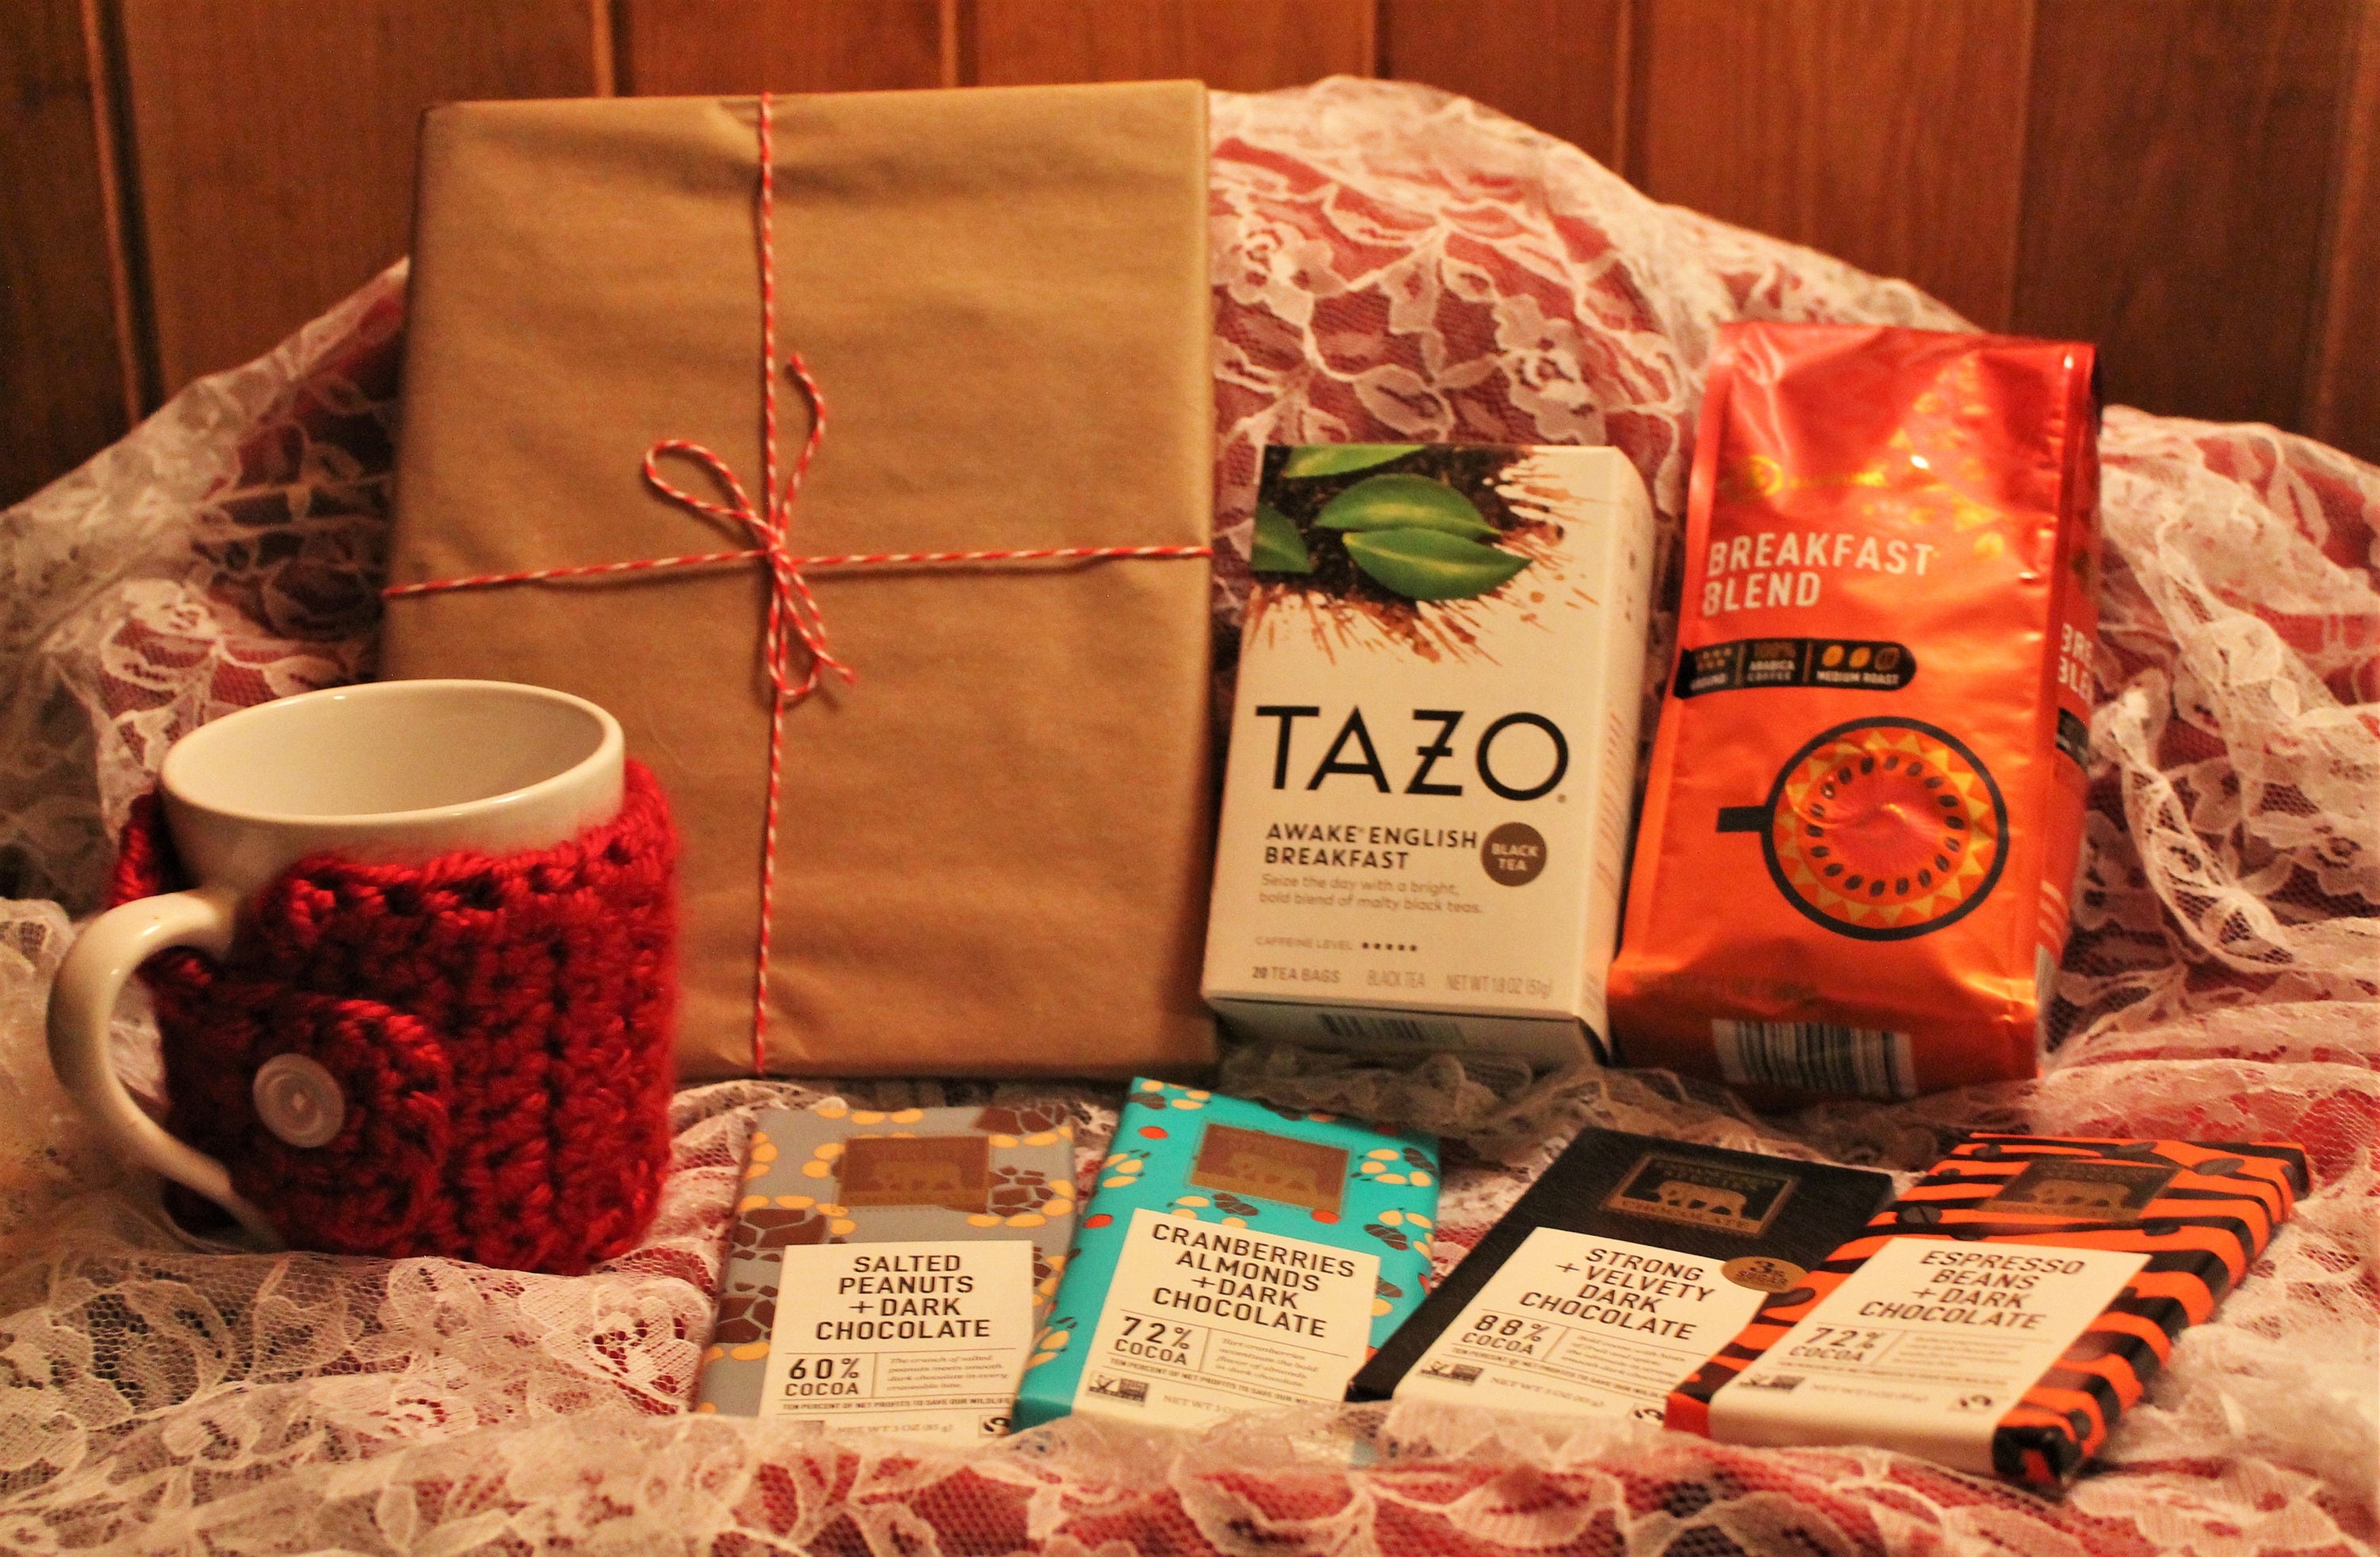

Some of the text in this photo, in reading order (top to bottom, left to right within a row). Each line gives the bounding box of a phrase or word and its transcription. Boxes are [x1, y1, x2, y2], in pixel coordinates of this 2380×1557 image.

[1706, 532, 1933, 577] BREAKFAST
[1702, 572, 1821, 617] BLEND
[1816, 671, 1899, 684] MEDIUM ROAST
[1255, 705, 1569, 802] TAZO
[1368, 826, 1478, 848] ENGLISH
[1265, 846, 1409, 870] BREAKFAST
[1491, 844, 1539, 858] BLACK
[1499, 858, 1526, 871] TEA
[1261, 873, 1299, 886] Seize
[1302, 876, 1326, 888] the
[1330, 877, 1355, 891] day
[1361, 879, 1393, 891] with
[1396, 882, 1407, 892] a
[1259, 892, 1290, 903] bold
[1295, 894, 1334, 905] blend
[1338, 894, 1354, 906] of
[1357, 897, 1399, 911] malty
[1404, 898, 1442, 911] black
[1254, 936, 1353, 951] CAFFEINE LEVEL
[1271, 966, 1298, 981] TEA
[1301, 968, 1341, 984] BAGS
[1366, 969, 1426, 989] BLACK TEA
[1446, 974, 1468, 991] NET
[1470, 975, 1489, 993] WT
[1152, 1223, 1355, 1277] CRANBERRIES
[853, 1254, 961, 1273] SALTED
[1176, 1251, 1320, 1292] ALMONDS
[1585, 1248, 1705, 1282] STRONG
[1919, 1251, 2085, 1274] ESPRESSO
[839, 1275, 974, 1295] PEANUTS
[1930, 1269, 2040, 1290] BEANS
[1577, 1282, 1658, 1313] DARK
[1153, 1287, 1326, 1338] CHOCOLATE
[1520, 1290, 1697, 1341] CHOCOLATE
[1858, 1301, 2047, 1329] CHOCOLATE
[816, 1320, 991, 1341] CHOCOLATE
[1121, 1316, 1193, 1349] 72%
[1473, 1314, 1550, 1342] 88%
[1805, 1326, 1887, 1348] 72%
[1115, 1339, 1188, 1366] COCOA
[1461, 1332, 1535, 1355] COCOA
[1788, 1346, 1864, 1362] COCOA
[788, 1357, 860, 1380] 60%
[785, 1382, 859, 1397] COCOA
